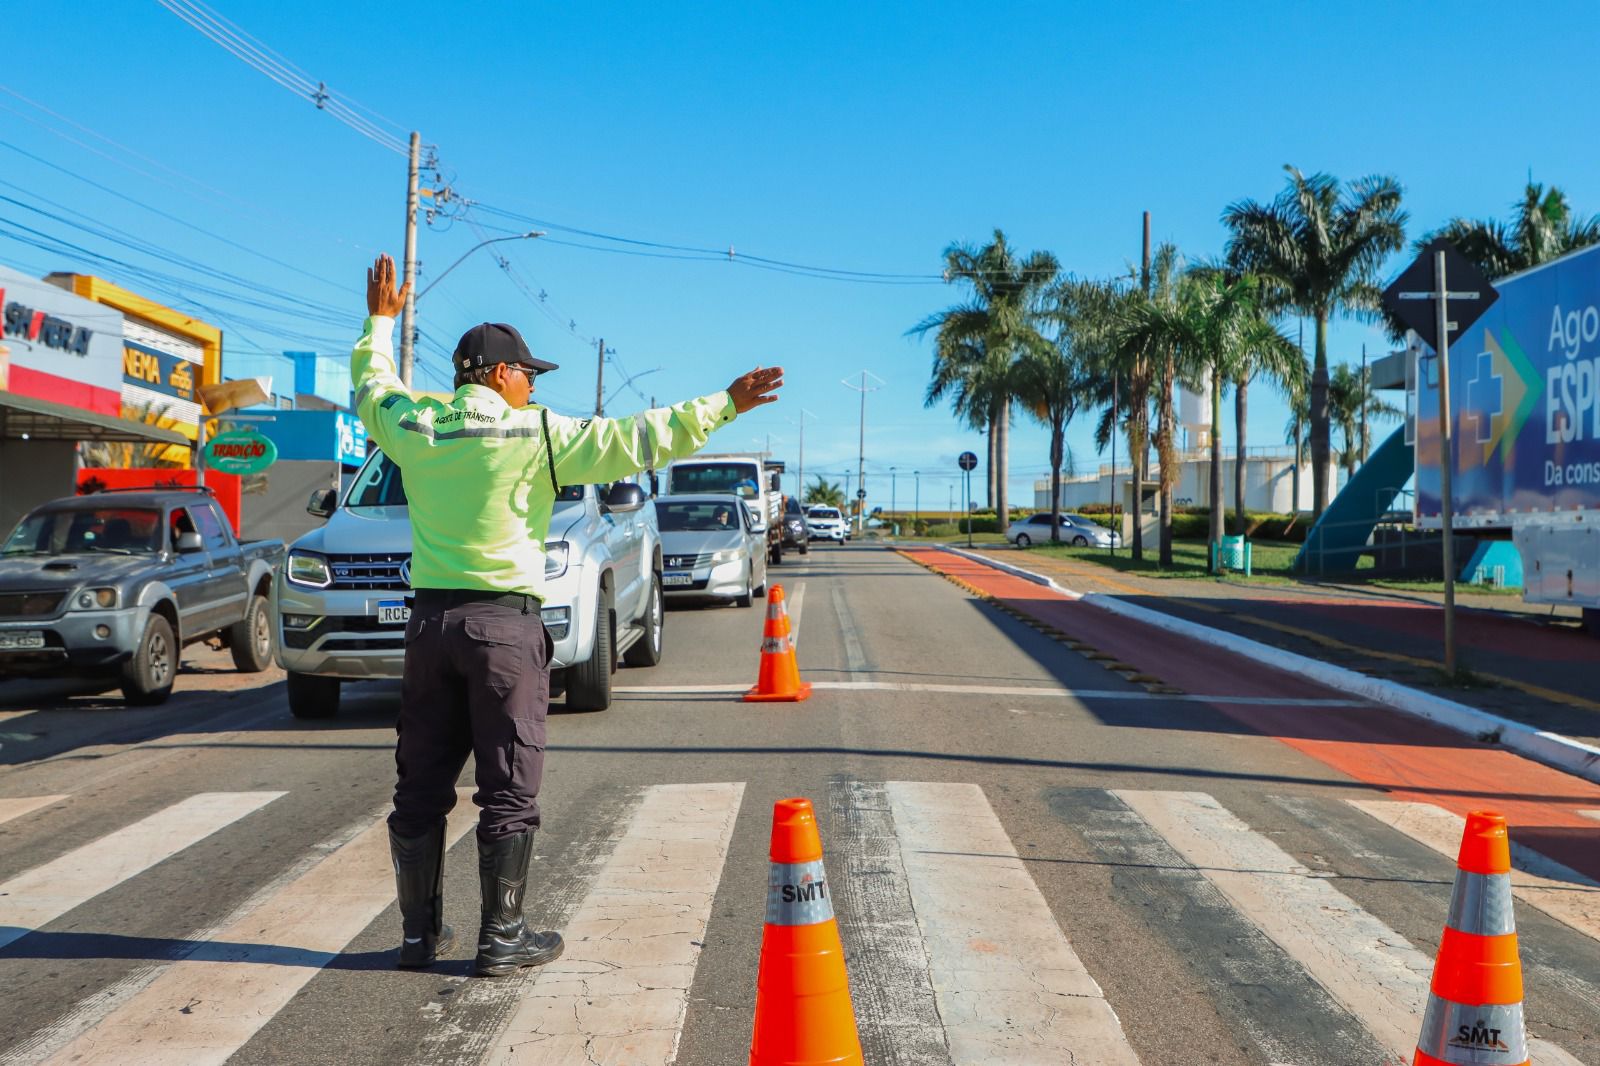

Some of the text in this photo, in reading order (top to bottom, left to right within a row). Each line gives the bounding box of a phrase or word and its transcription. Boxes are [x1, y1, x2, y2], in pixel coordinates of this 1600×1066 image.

[1548, 304, 1599, 360] Ago
[123, 346, 161, 385] NEMA
[434, 414, 453, 424] AGETE
[454, 411, 462, 421] DE
[213, 439, 266, 460] TRADIÇÃO
[1544, 459, 1600, 486] Da cons
[385, 607, 409, 621] RCE
[782, 880, 825, 903] SMT
[1459, 1024, 1501, 1045] SMT
